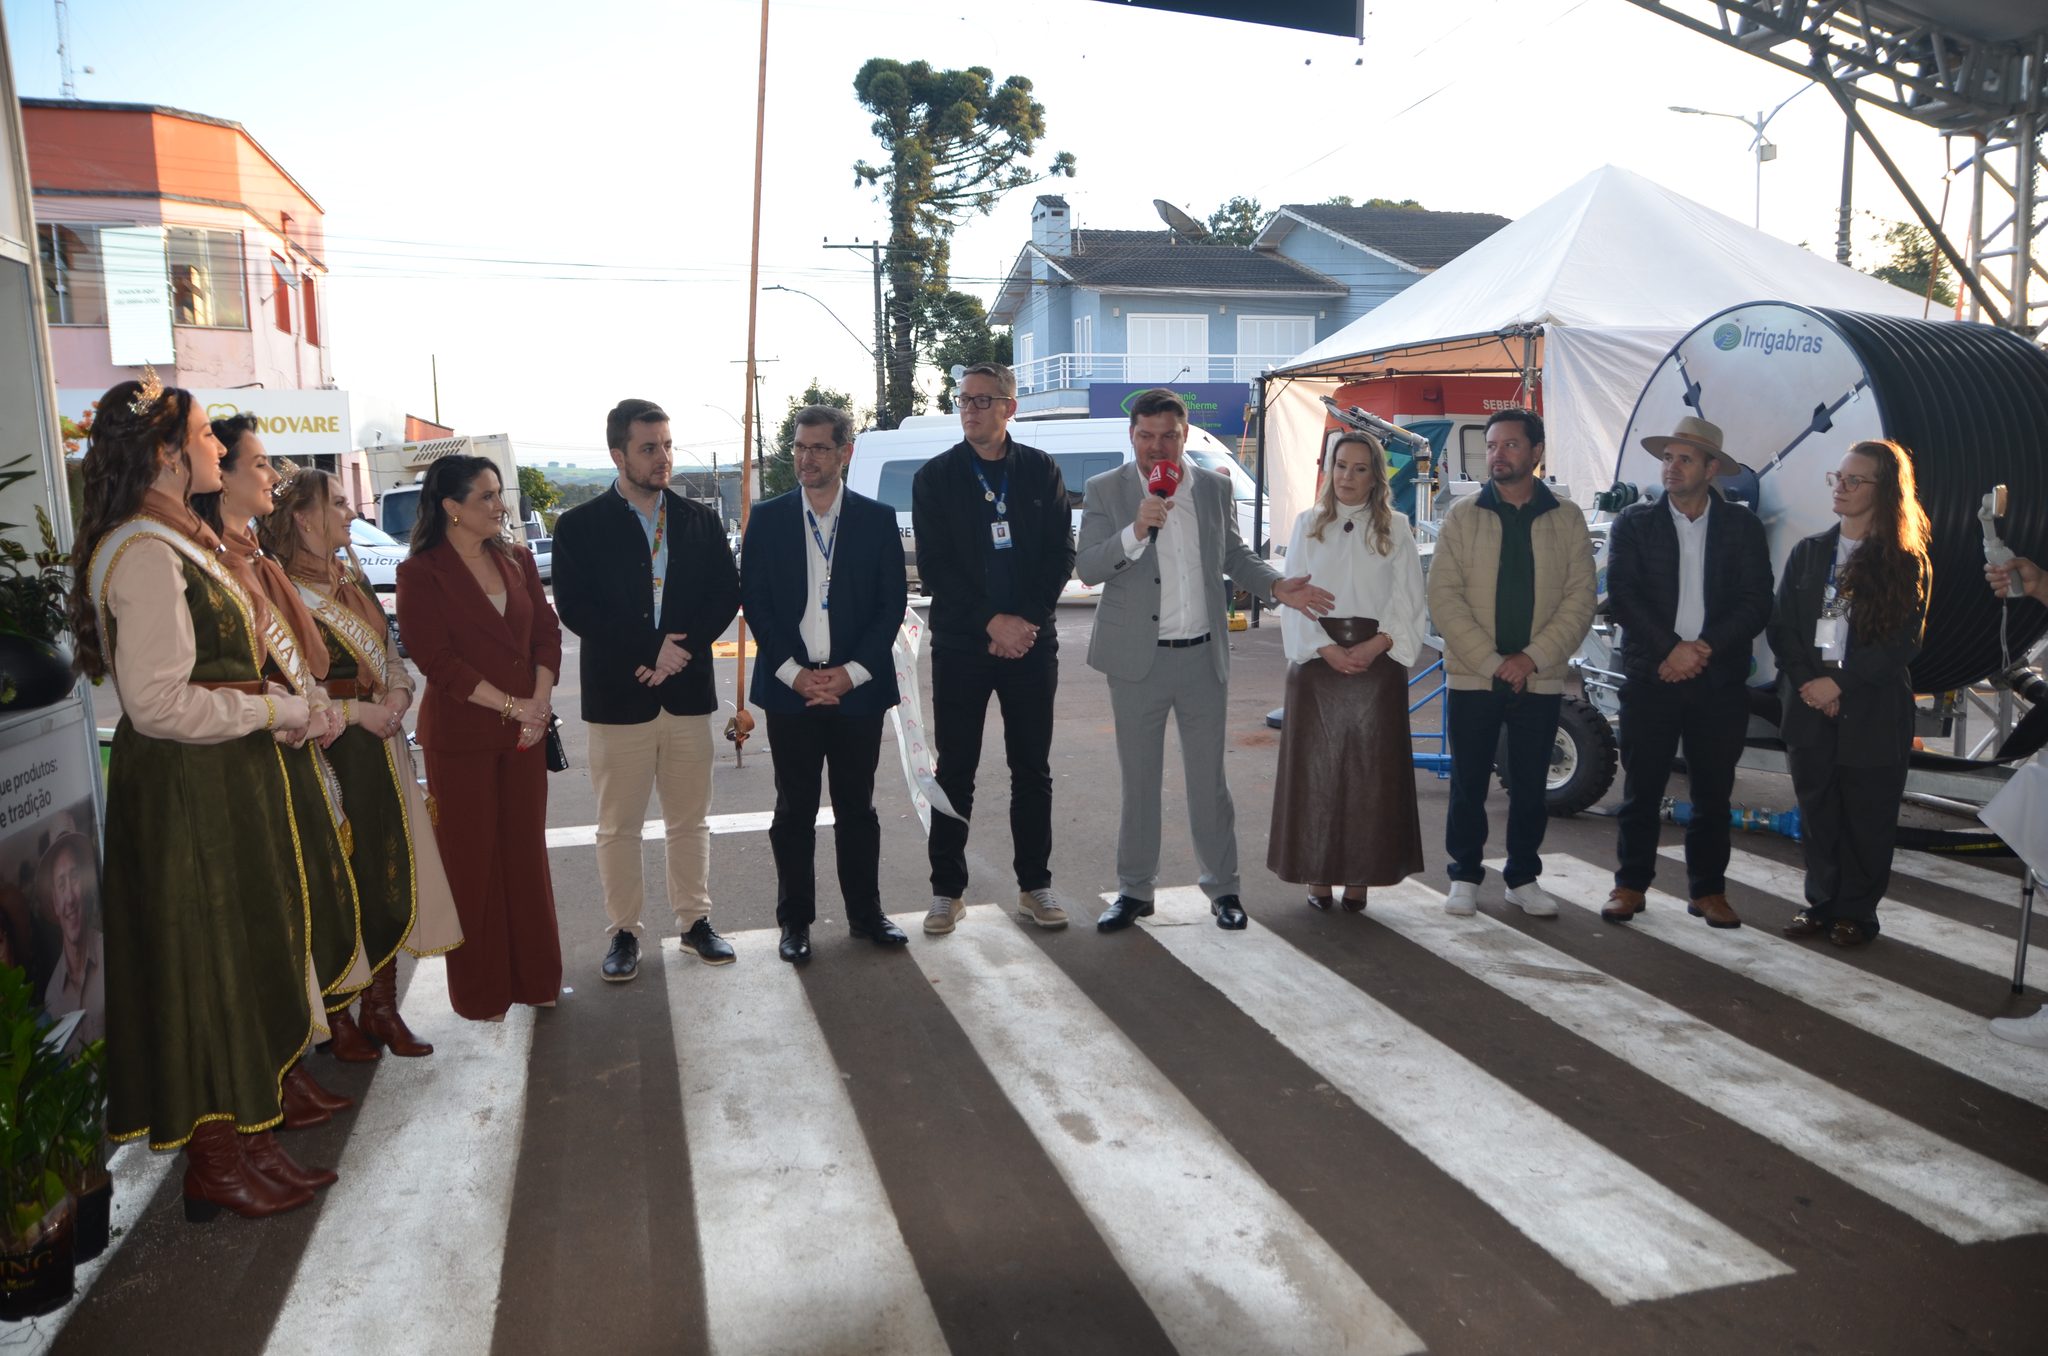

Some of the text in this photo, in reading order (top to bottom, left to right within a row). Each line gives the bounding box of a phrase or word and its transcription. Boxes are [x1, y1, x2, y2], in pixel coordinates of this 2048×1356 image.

[1743, 325, 1823, 355] Irrigabras
[257, 416, 340, 434] NOVARE
[359, 556, 401, 566] OLÍCIA
[0, 759, 58, 796] ue produtos:
[8, 788, 52, 824] tradição
